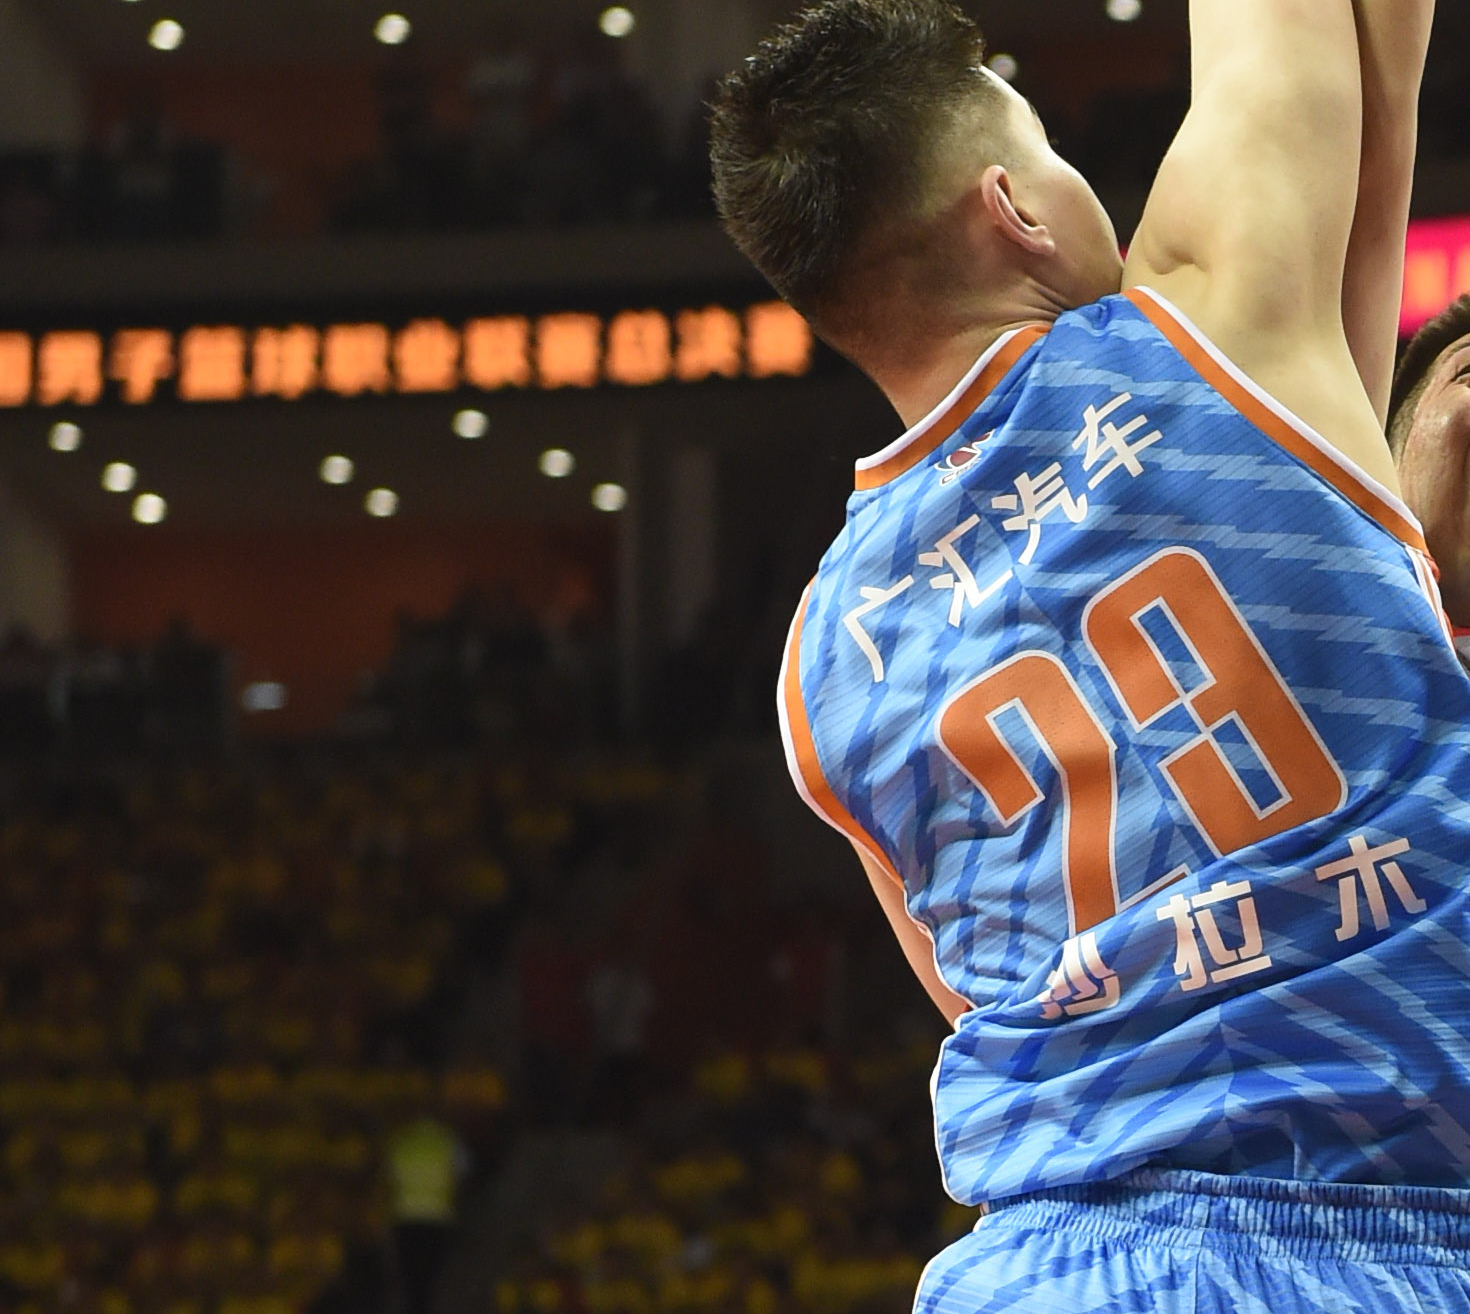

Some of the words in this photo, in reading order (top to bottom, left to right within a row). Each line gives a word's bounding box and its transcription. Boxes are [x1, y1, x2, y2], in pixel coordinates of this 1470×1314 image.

[843, 392, 1163, 682] 广汇汽车
[936, 545, 1349, 935] 23
